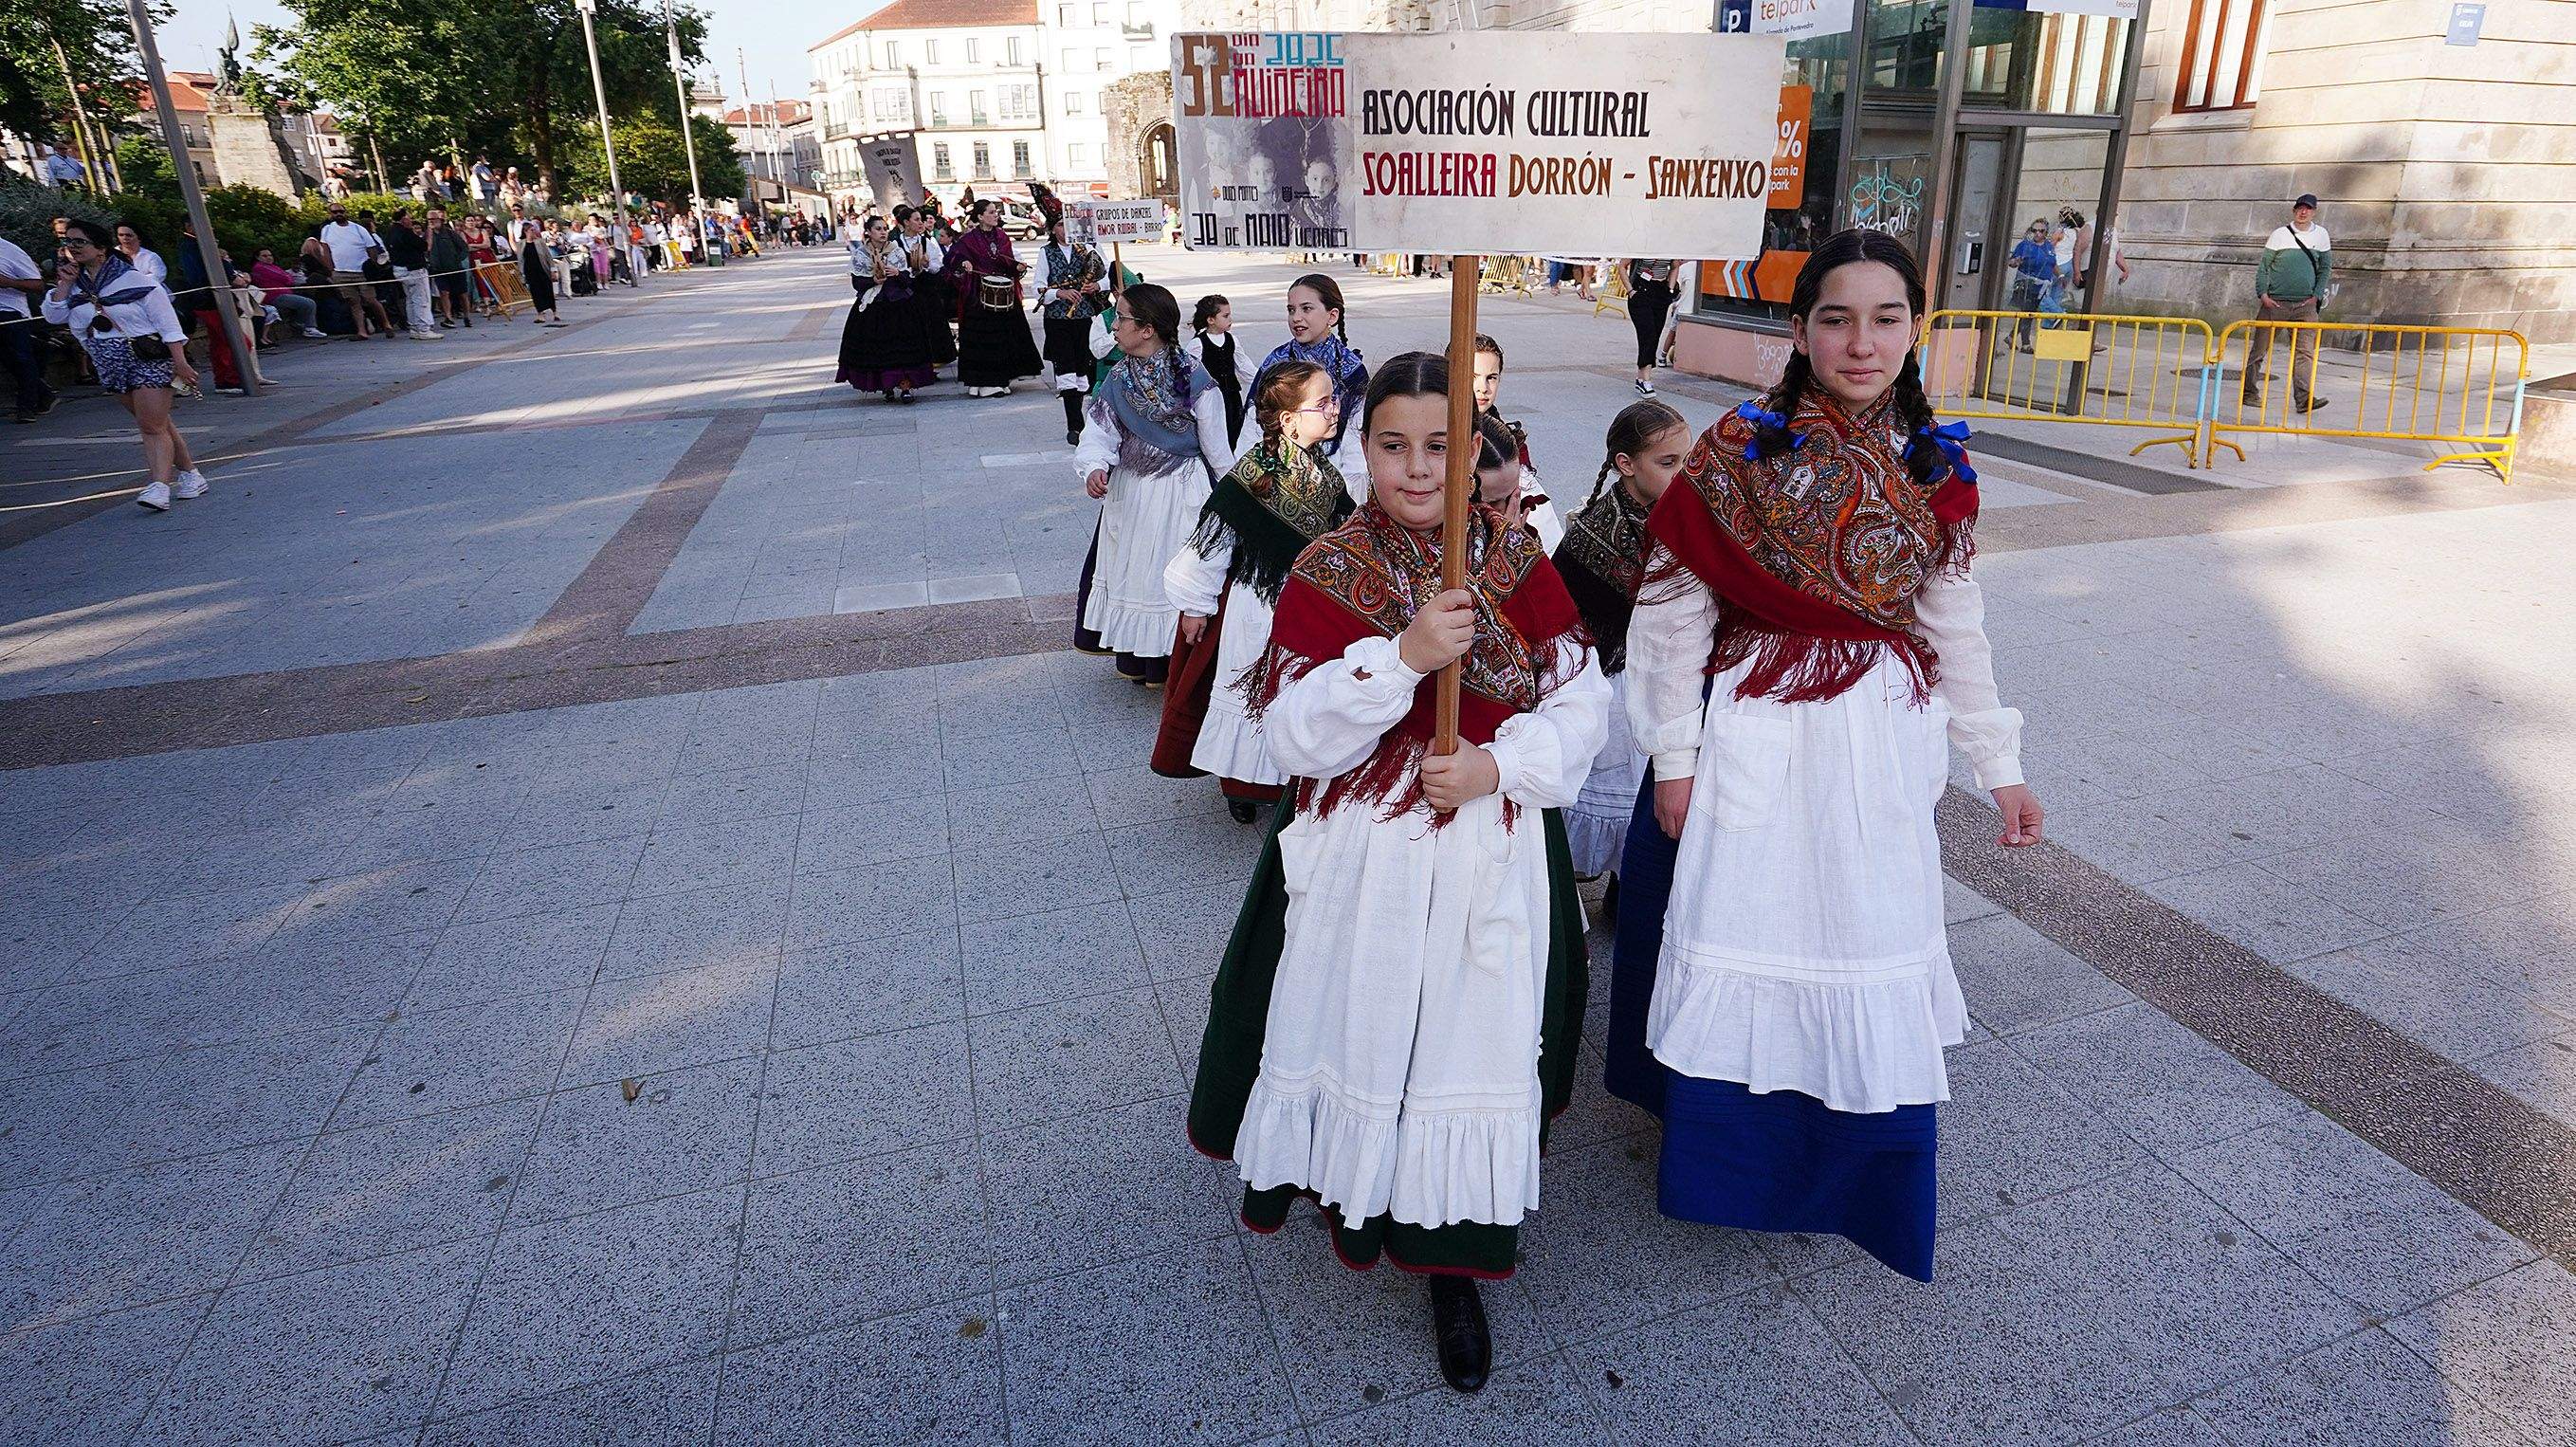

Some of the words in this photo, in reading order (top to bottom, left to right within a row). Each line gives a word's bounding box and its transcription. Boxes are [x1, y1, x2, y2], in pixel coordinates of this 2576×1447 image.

[1265, 34, 1343, 65] 2025
[1180, 35, 1233, 116] 52
[1362, 82, 1516, 139] ASOCIACIÓN
[1526, 90, 1651, 137] CULTURAL
[1362, 152, 1497, 197] SOALLEIRA
[1508, 151, 1613, 198] DORRÓN
[1645, 156, 1766, 201] SANXENXO
[1773, 167, 1789, 176] con
[1790, 164, 1799, 176] la
[1096, 208, 1120, 221] GRUPOS
[1122, 208, 1129, 219] DE
[1192, 213, 1218, 246] 30
[1225, 227, 1240, 246] DE
[1245, 213, 1290, 247] MAIO
